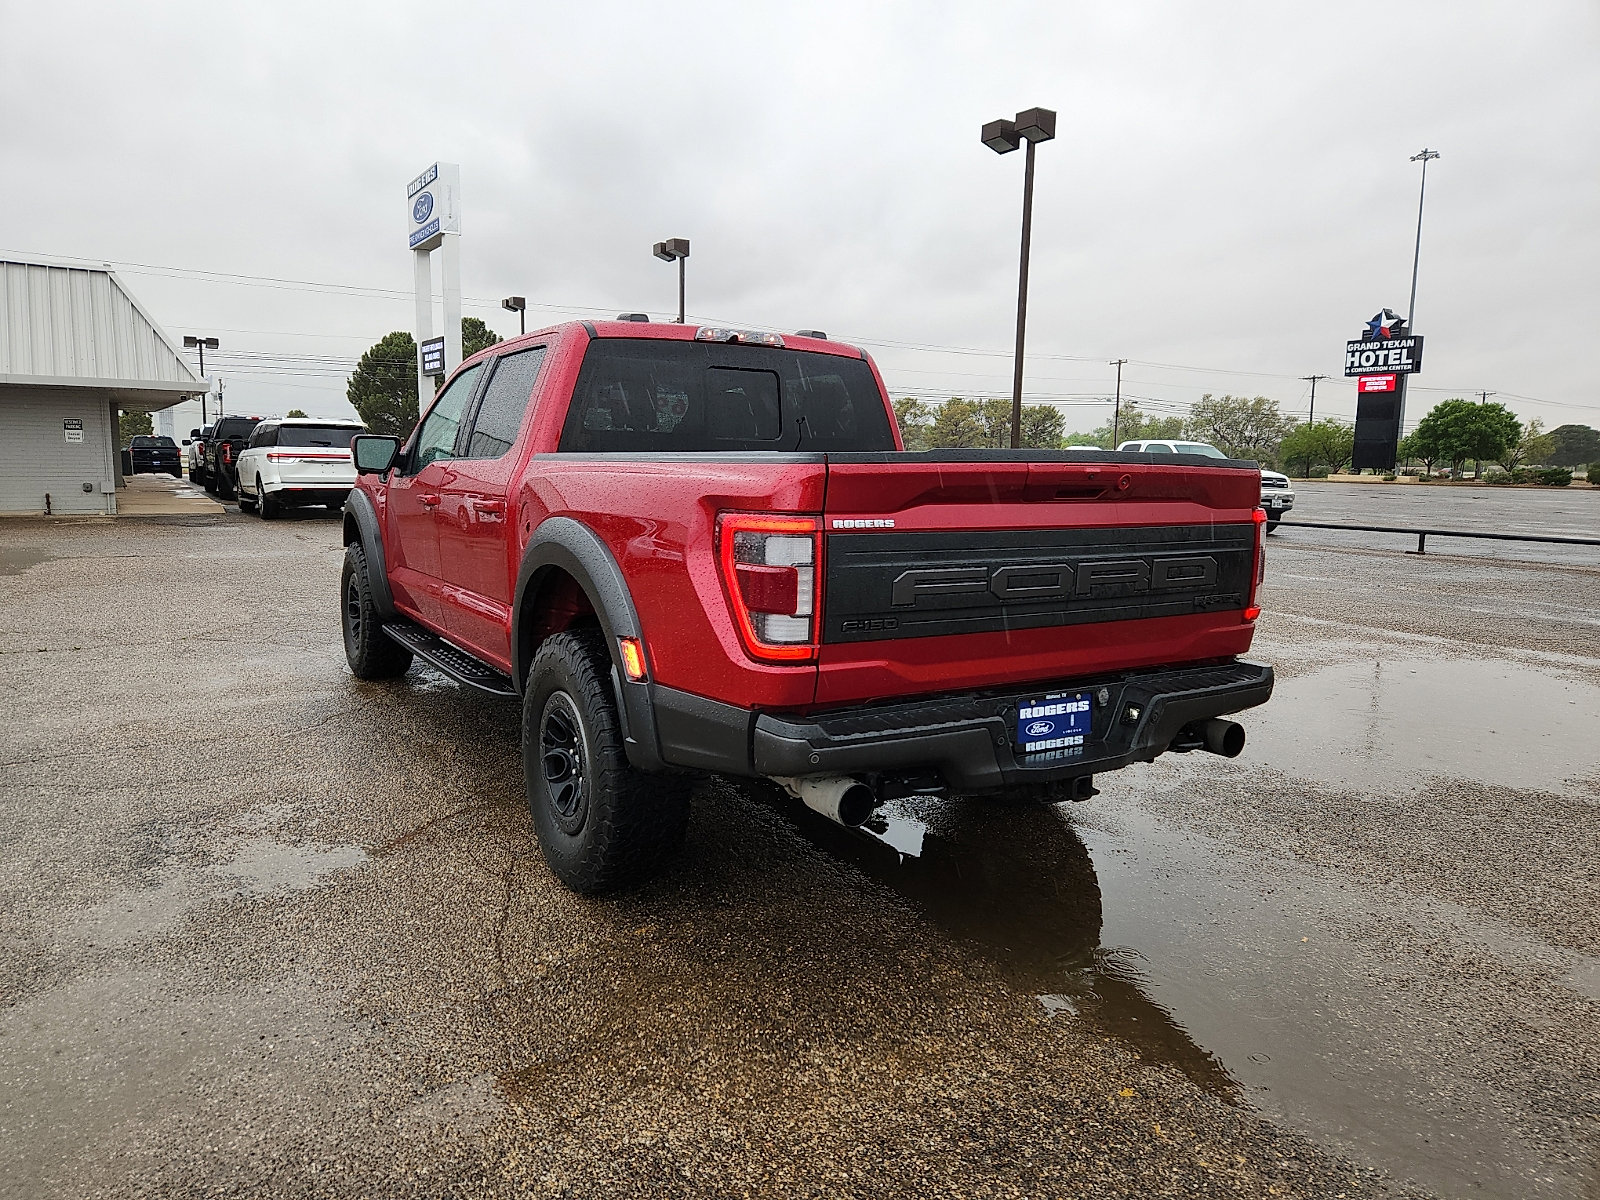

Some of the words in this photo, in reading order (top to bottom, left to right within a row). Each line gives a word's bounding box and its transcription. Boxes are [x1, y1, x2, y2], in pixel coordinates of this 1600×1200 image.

[408, 166, 437, 197] ROGERS
[1348, 343, 1380, 351] GRAND
[1382, 339, 1415, 349] TEXAN
[1346, 348, 1413, 368] HOTEL
[831, 518, 896, 529] ROGERS
[891, 555, 1219, 608] FORD
[841, 617, 898, 633] F-150
[1019, 701, 1089, 719] ROGERS
[1031, 723, 1049, 733] Ford
[1025, 735, 1084, 752] ROGERS
